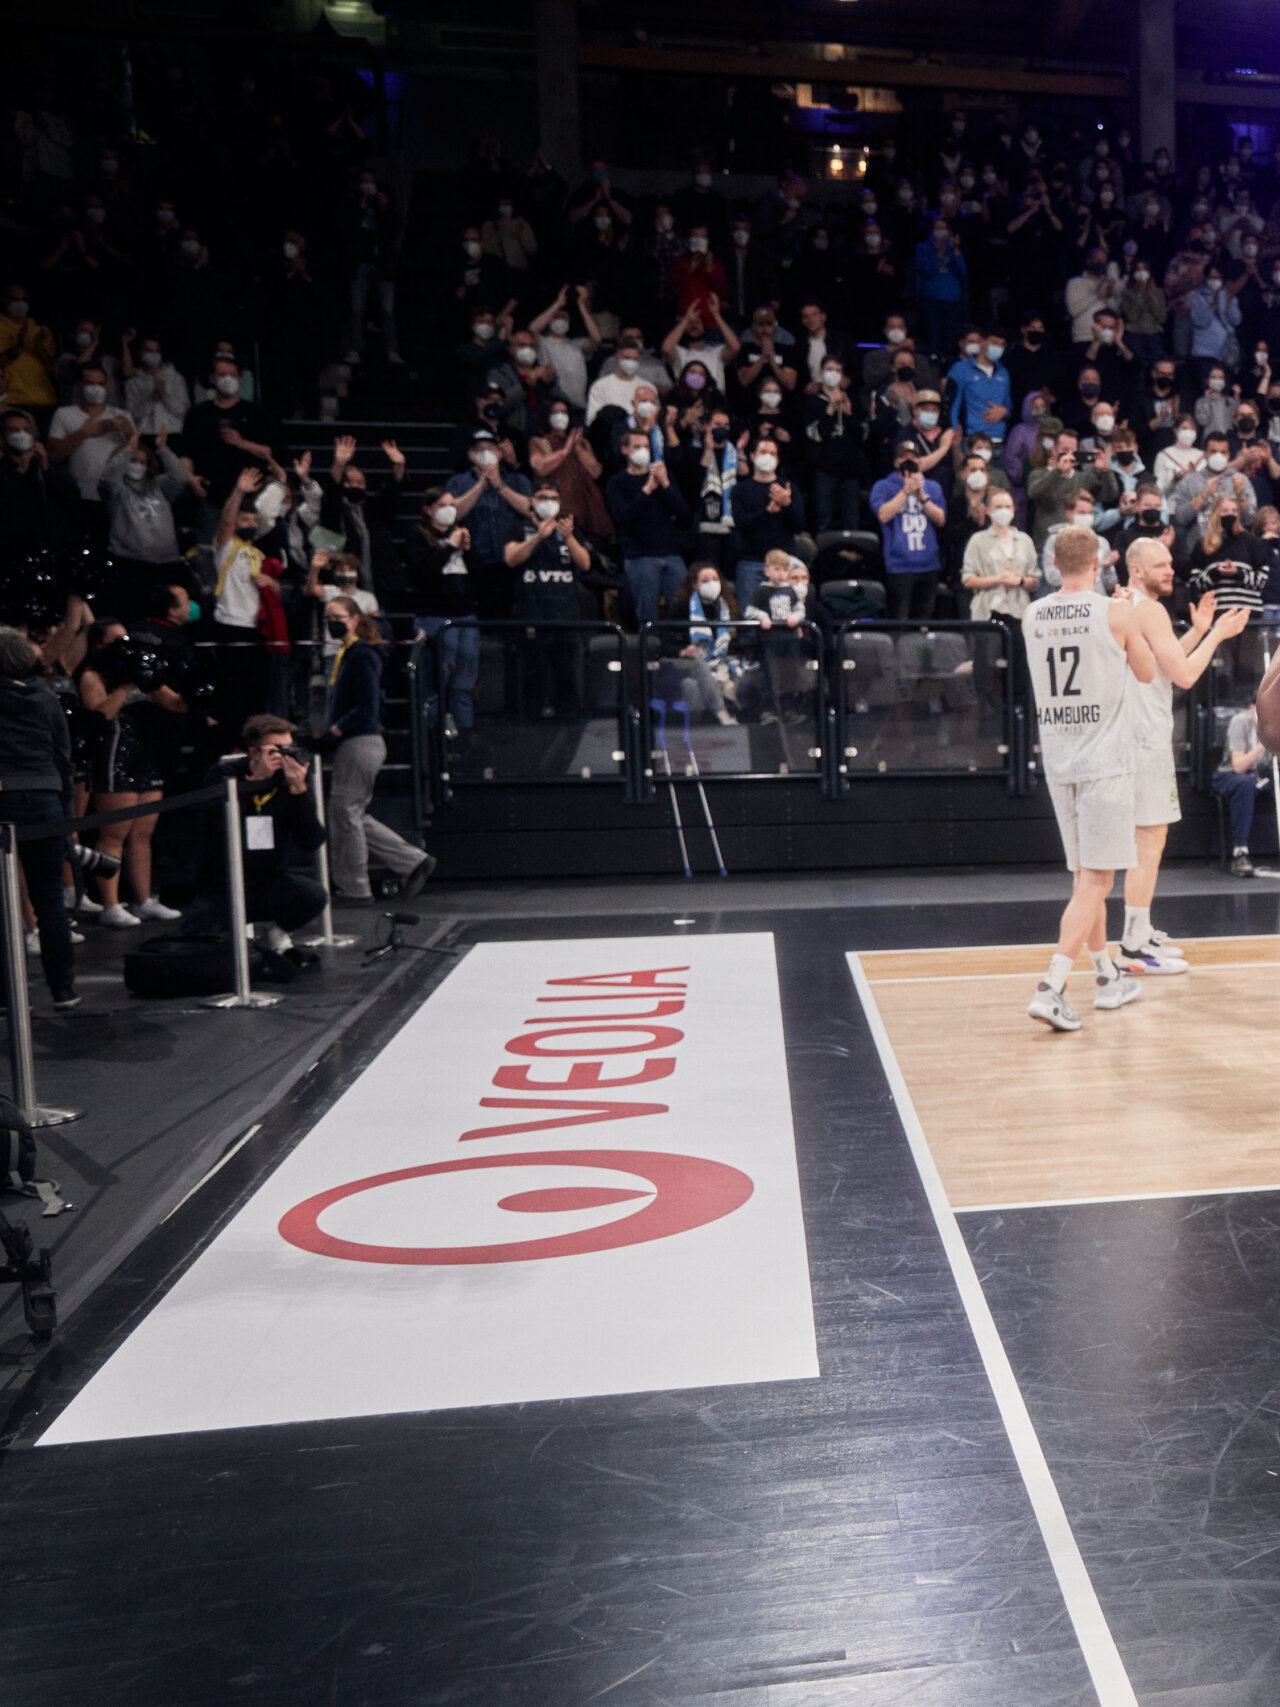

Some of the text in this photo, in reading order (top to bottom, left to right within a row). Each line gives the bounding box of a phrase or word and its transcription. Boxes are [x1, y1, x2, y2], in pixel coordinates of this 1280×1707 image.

[902, 513, 927, 533] DO
[539, 569, 574, 584] VTG
[1036, 604, 1091, 620] HINRICHS
[1062, 626, 1090, 636] BLACK
[1047, 646, 1081, 697] 12
[1037, 705, 1100, 725] HAMBURG
[458, 966, 690, 1142] VEOLIA
